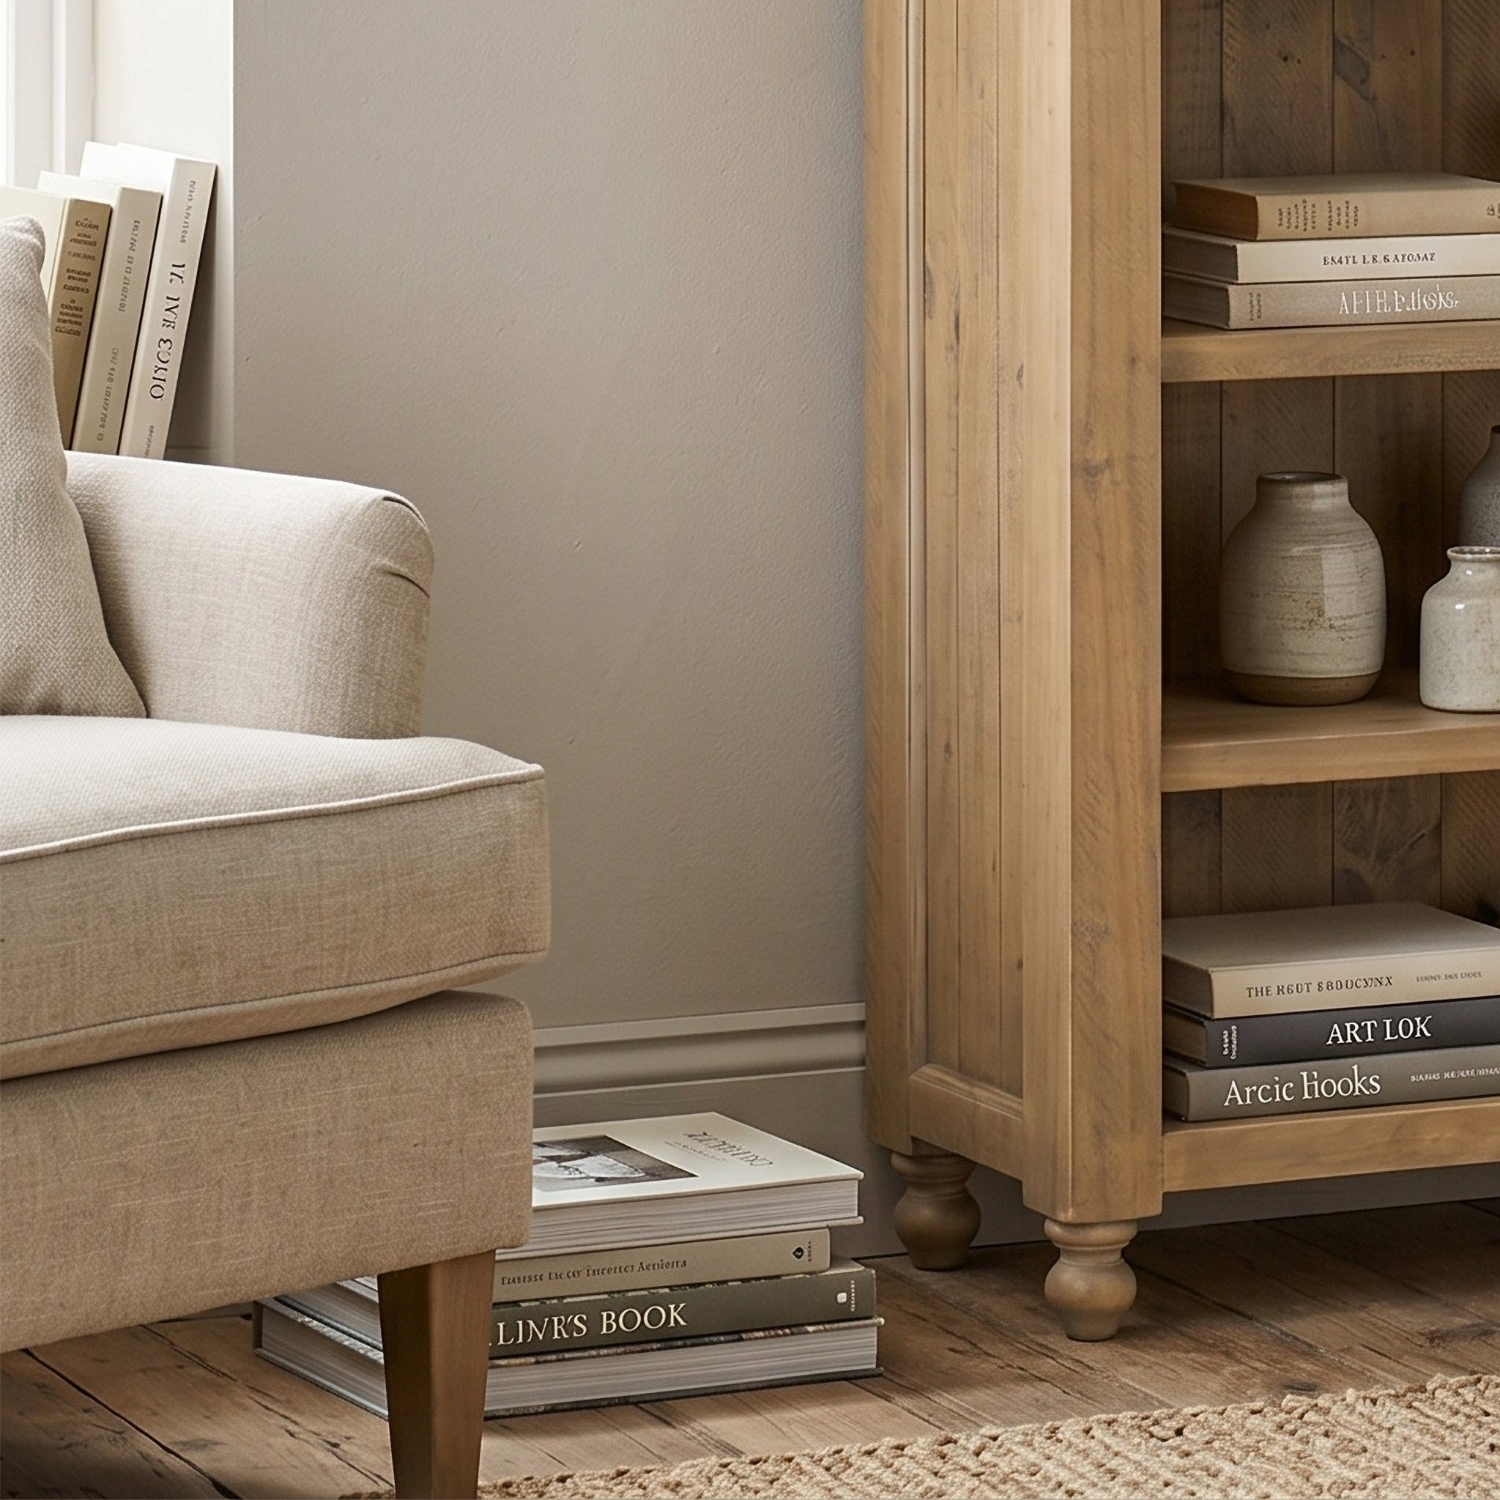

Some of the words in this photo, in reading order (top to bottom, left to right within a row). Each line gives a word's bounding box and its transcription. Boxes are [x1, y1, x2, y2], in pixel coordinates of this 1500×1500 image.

[1246, 986, 1272, 998] THE
[1326, 1020, 1378, 1045] ART
[1382, 1015, 1432, 1041] LOK
[1223, 1076, 1295, 1107] Arcic
[600, 1302, 688, 1335] BOOK
